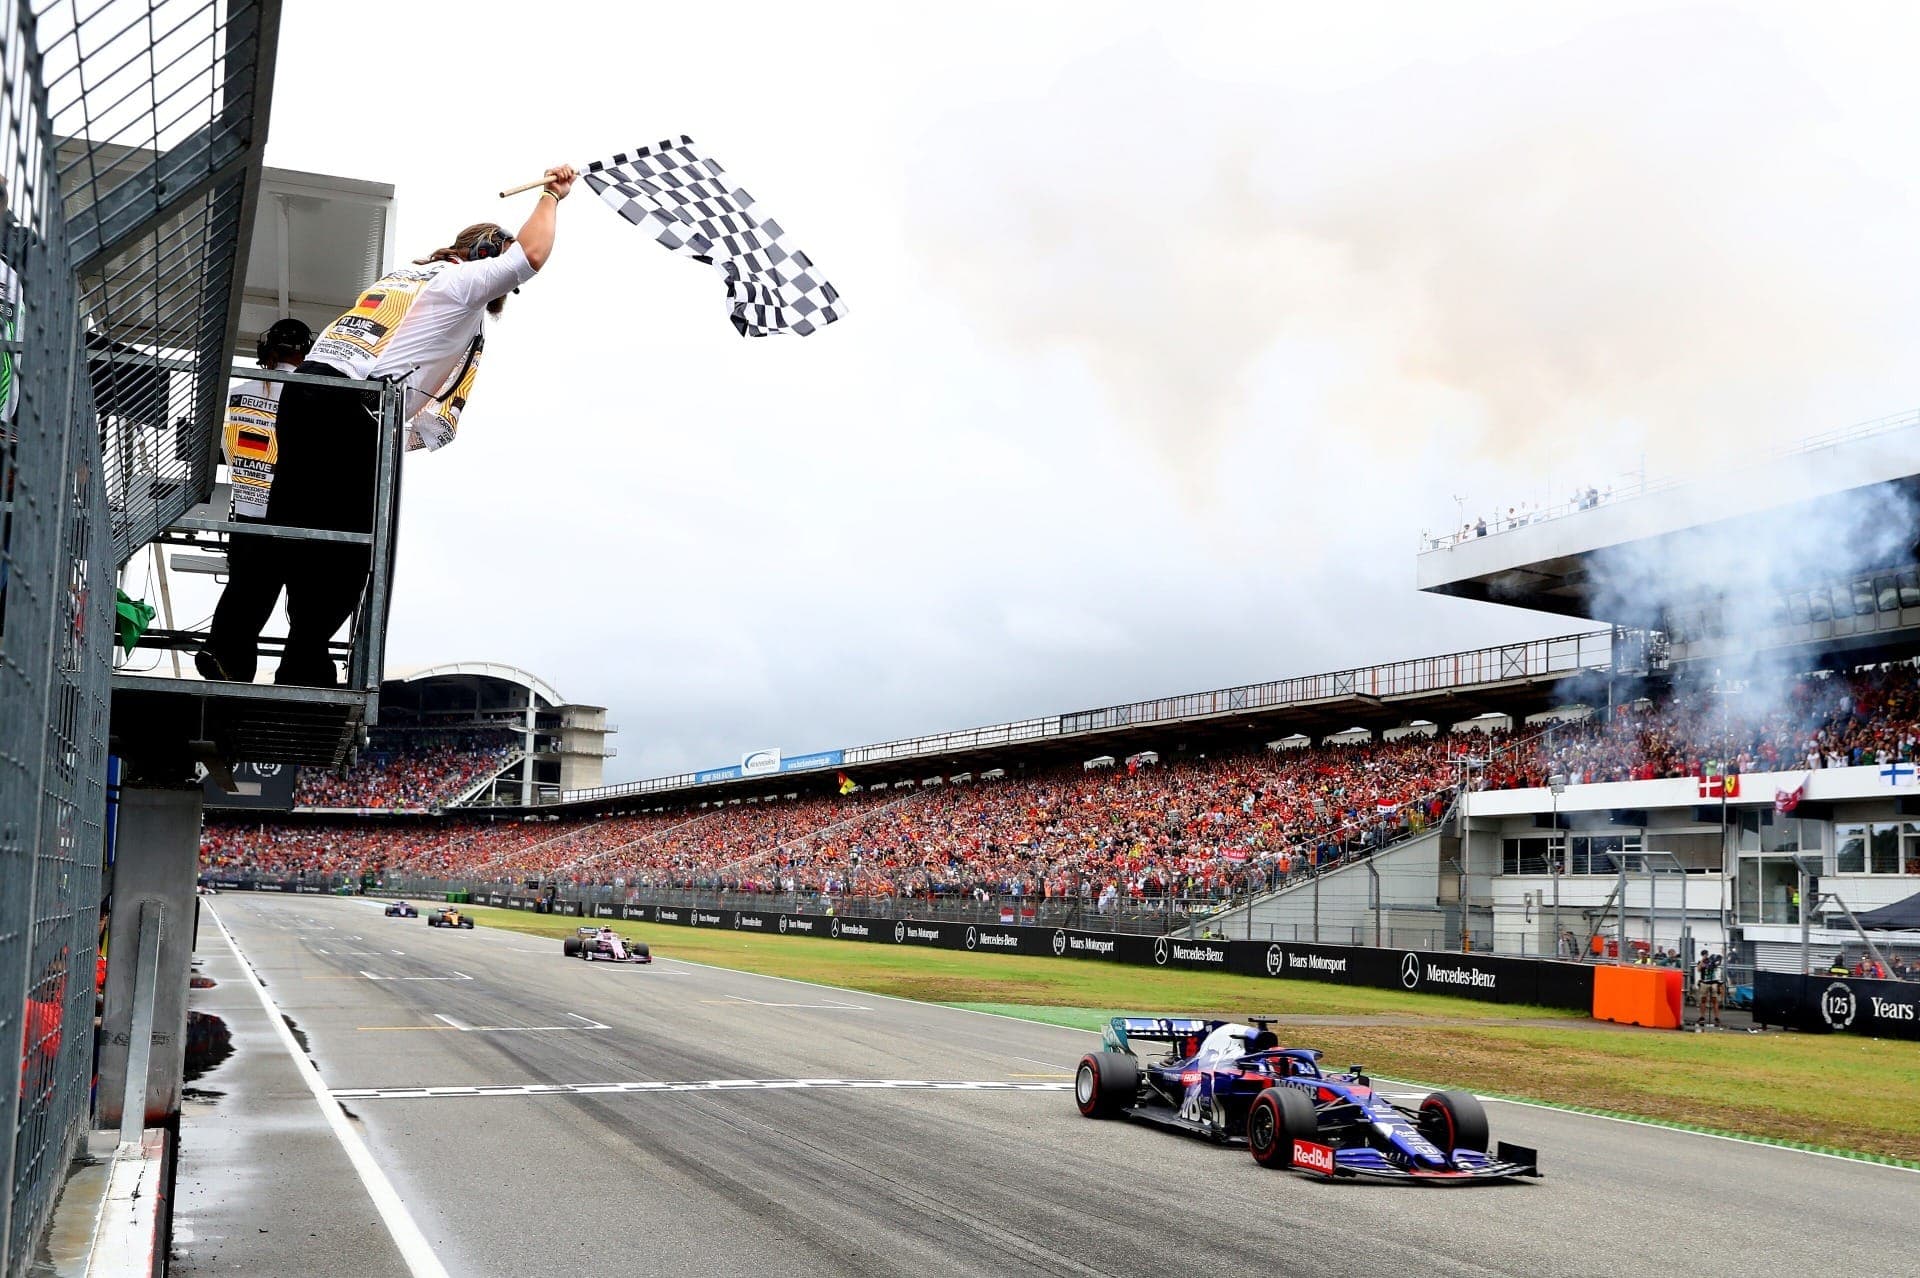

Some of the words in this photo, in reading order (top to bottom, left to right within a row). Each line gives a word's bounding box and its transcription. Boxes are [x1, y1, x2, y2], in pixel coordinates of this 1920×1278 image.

[350, 318, 375, 331] LANE
[243, 459, 273, 473] LANE
[1173, 944, 1224, 962] Mercedes-Benz
[1289, 953, 1308, 968] Years
[1309, 954, 1346, 974] Motorsport
[1426, 963, 1496, 988] Mercedes-Benz
[1829, 996, 1848, 1015] 125
[1871, 996, 1914, 1020] Years
